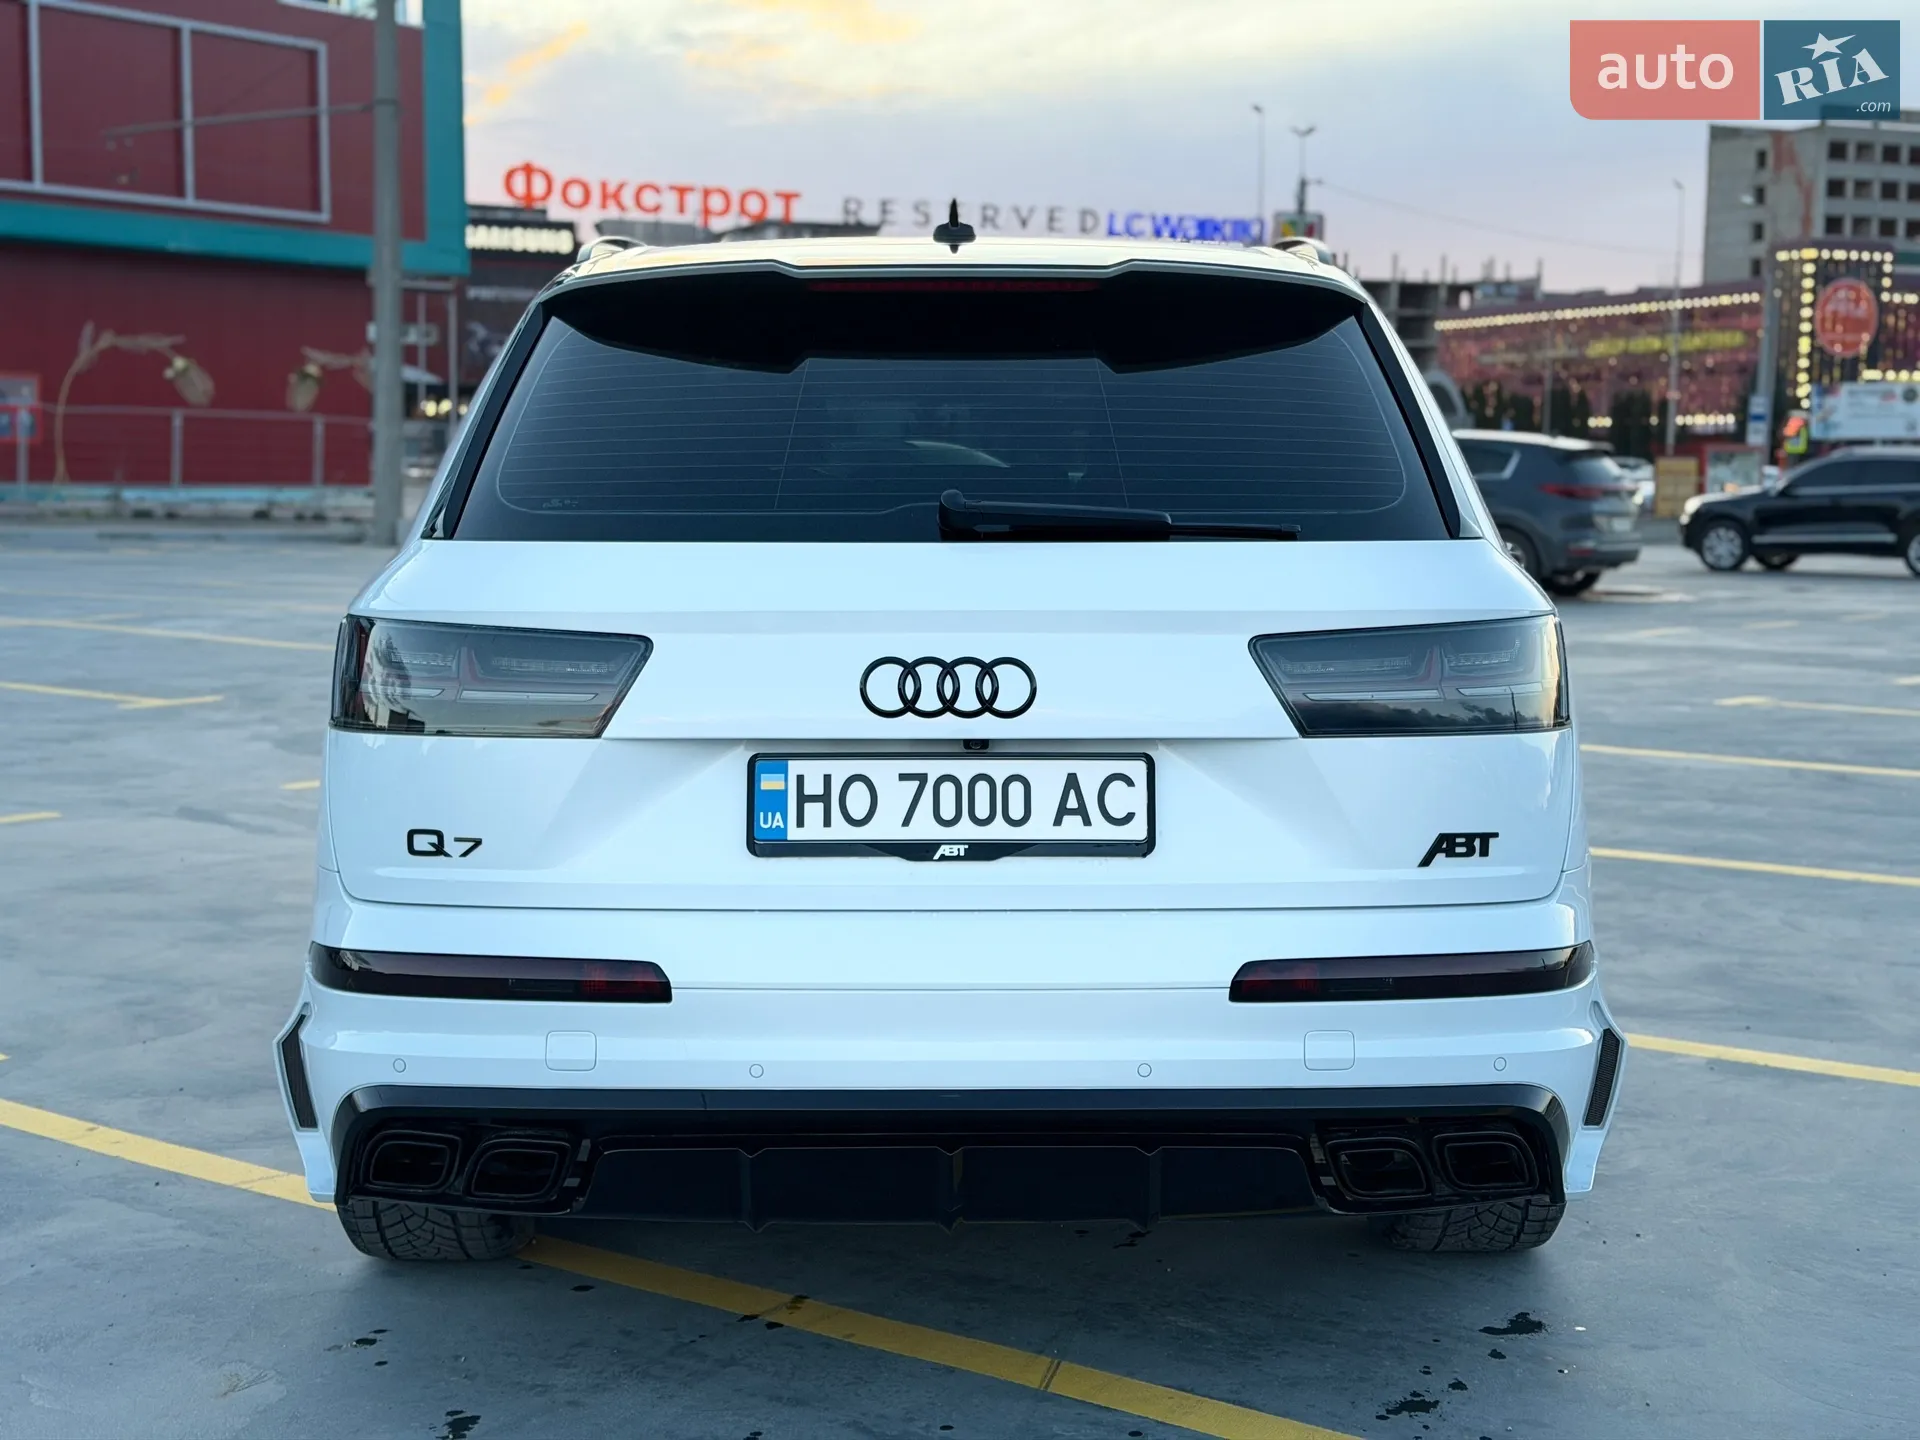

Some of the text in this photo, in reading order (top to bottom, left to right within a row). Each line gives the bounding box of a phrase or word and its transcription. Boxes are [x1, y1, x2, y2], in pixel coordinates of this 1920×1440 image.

[503, 161, 802, 227] Фокстрот
[796, 772, 1136, 829] HO 7000 AC
[759, 811, 785, 829] UA
[406, 828, 483, 858] Q7
[932, 844, 969, 862] ABT
[1417, 831, 1500, 868] ABT
